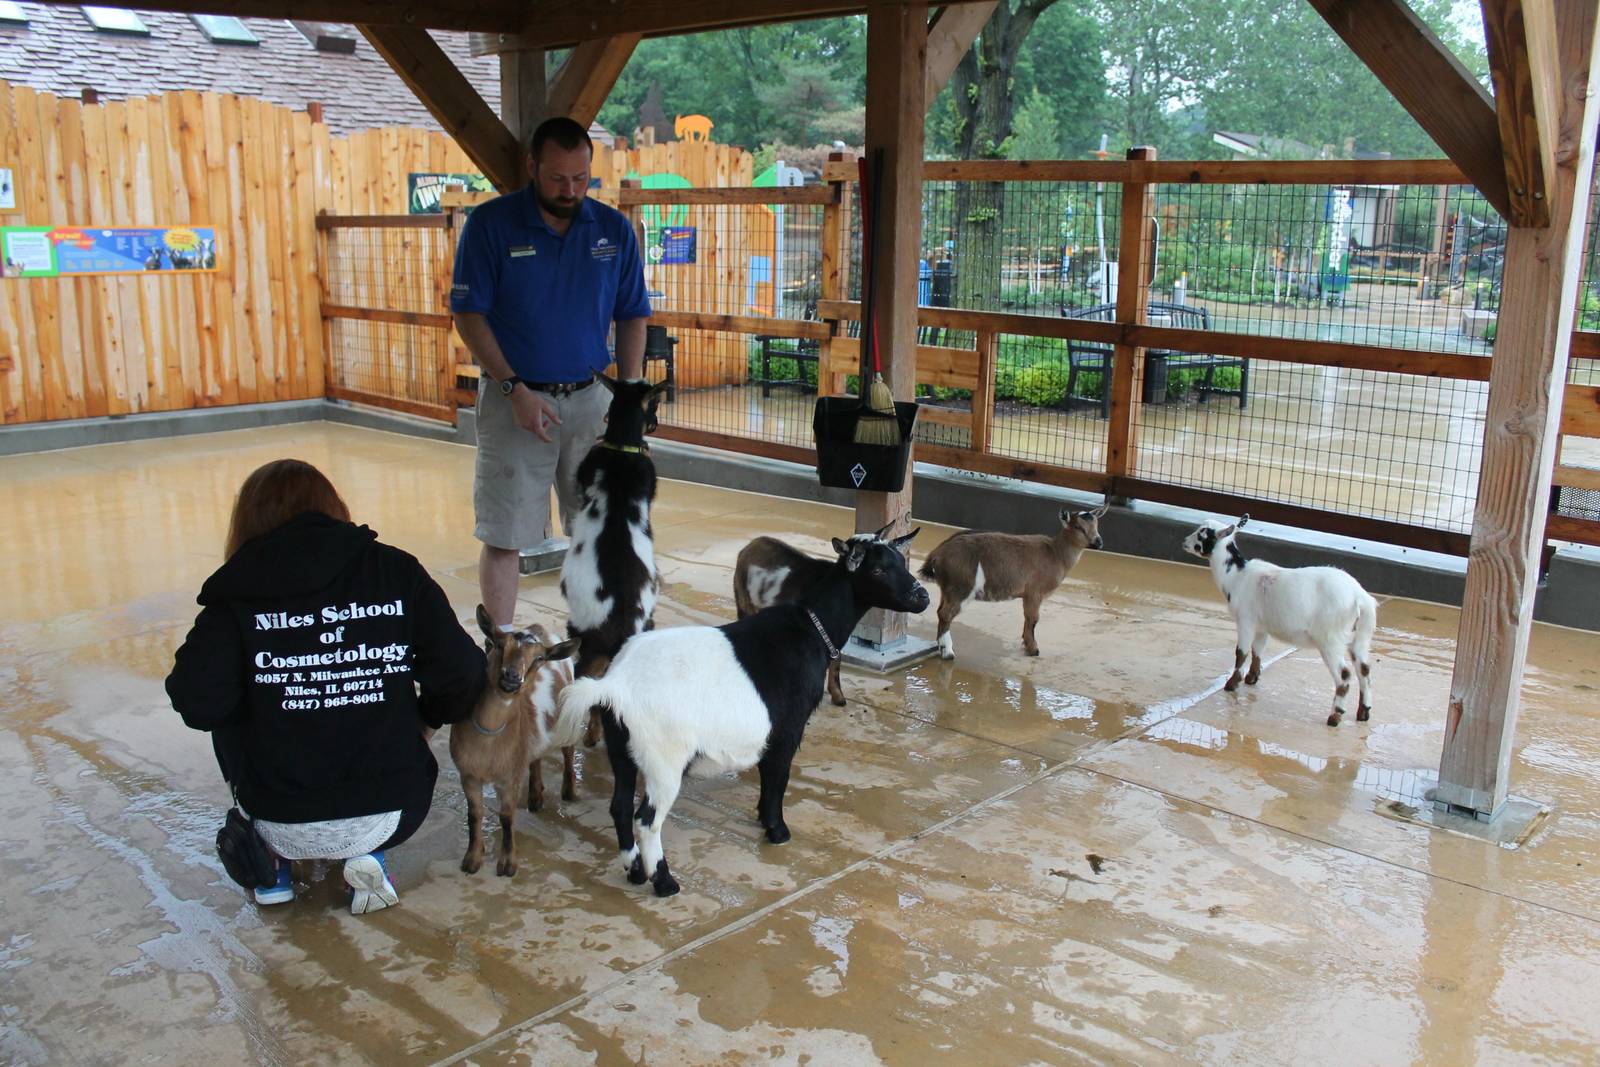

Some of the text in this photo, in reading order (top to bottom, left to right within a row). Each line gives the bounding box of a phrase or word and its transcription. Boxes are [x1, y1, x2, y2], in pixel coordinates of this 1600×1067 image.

[254, 599, 404, 631] Niles School
[319, 626, 345, 644] of
[254, 643, 409, 669] Cosmetology
[254, 663, 411, 684] 8057 N. Milwaukee Ave.
[284, 678, 384, 696] Niles, IL 60714
[281, 692, 386, 710] (847) 965-8061
